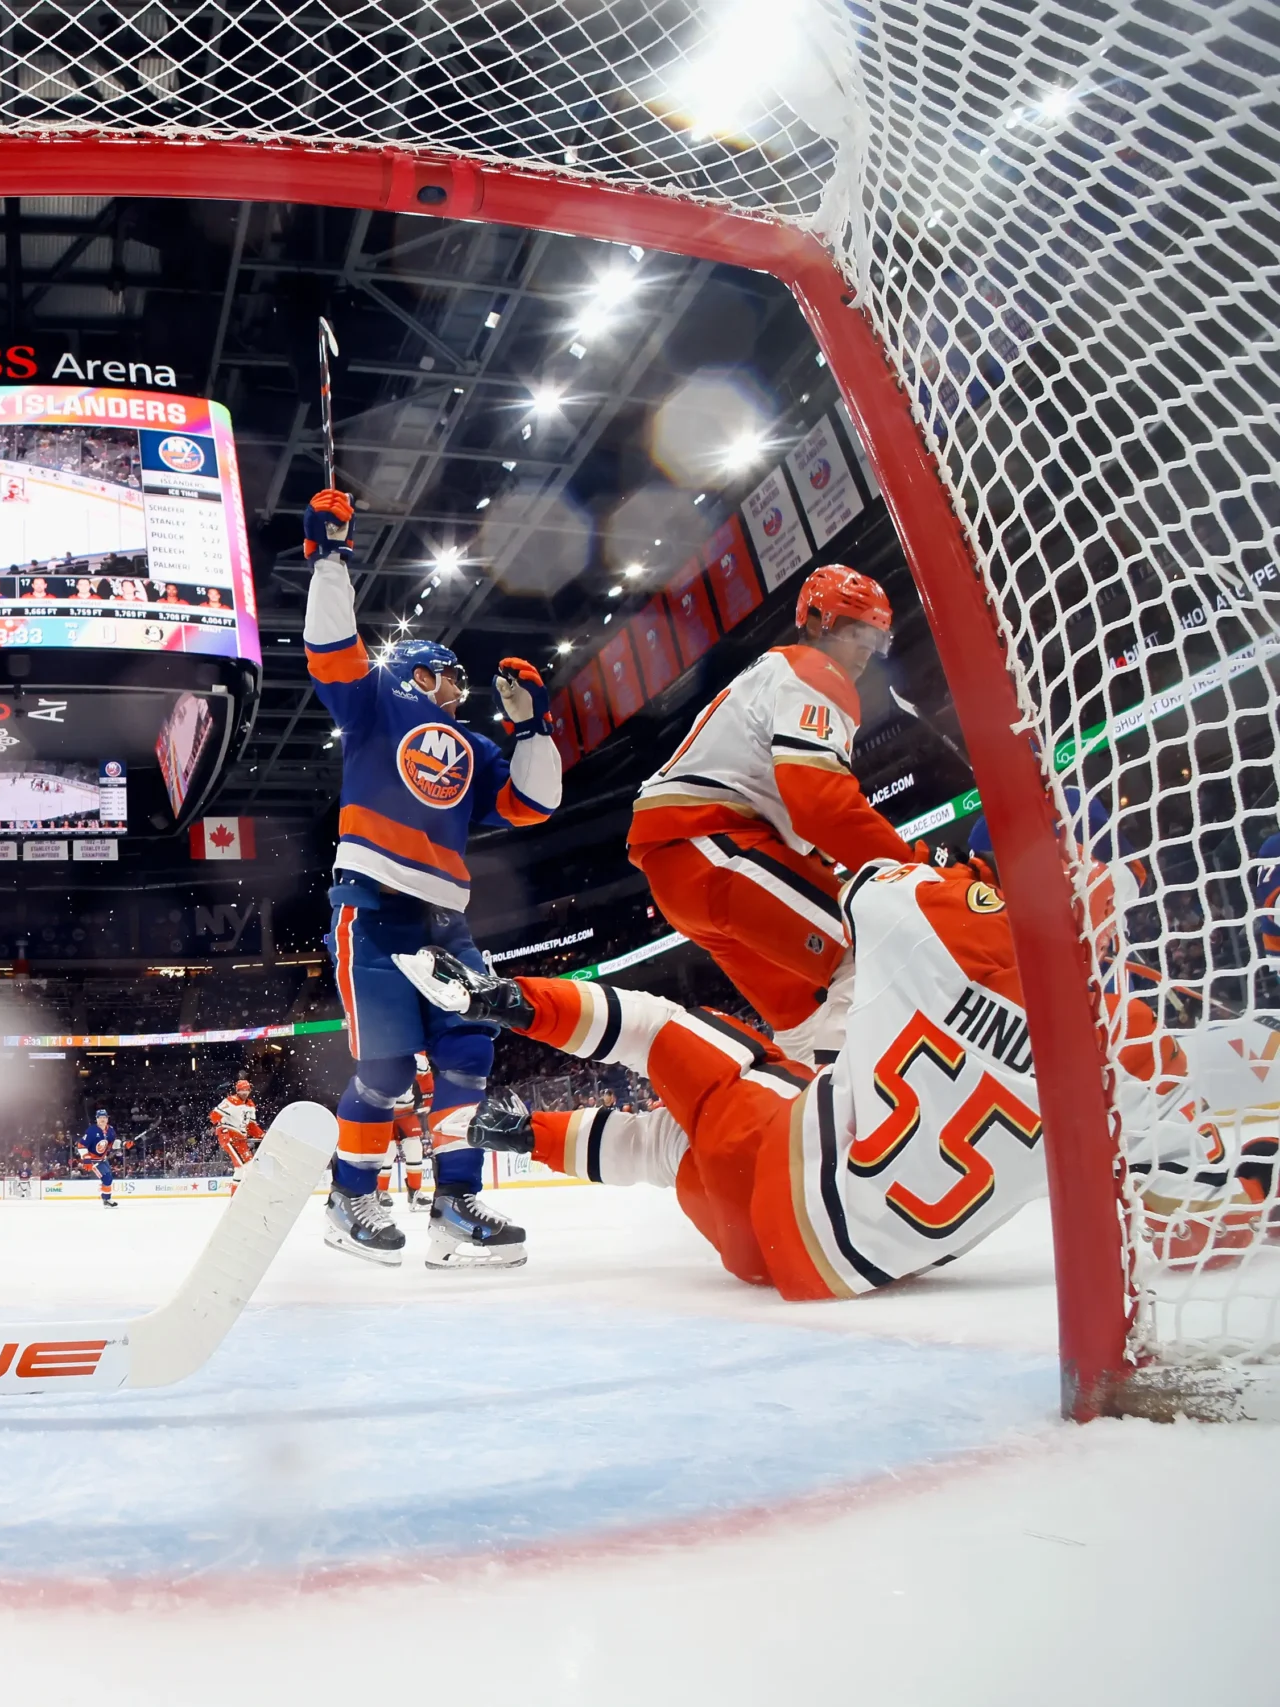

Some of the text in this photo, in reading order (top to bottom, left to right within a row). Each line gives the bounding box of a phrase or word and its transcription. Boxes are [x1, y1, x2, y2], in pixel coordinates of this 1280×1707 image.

[52, 353, 176, 386] Arena
[14, 394, 186, 424] ISLANDERS
[168, 488, 199, 498] ICE TIME
[150, 517, 186, 527] STANLEY
[151, 532, 184, 540] PULOCK
[152, 546, 185, 555] PELECH
[154, 561, 190, 571] PALMIERI
[20, 579, 30, 587] 17
[65, 579, 75, 587] 12
[2, 608, 12, 616] FT
[180, 614, 190, 622] FT
[222, 618, 232, 626] FT
[68, 630, 77, 641] 4
[799, 703, 832, 740] 4
[405, 758, 460, 798] ISLANDERS
[944, 987, 1036, 1076] HIND
[24, 1037, 41, 1046] 3:33
[848, 1009, 1043, 1239] 55
[112, 1182, 136, 1192] UBS
